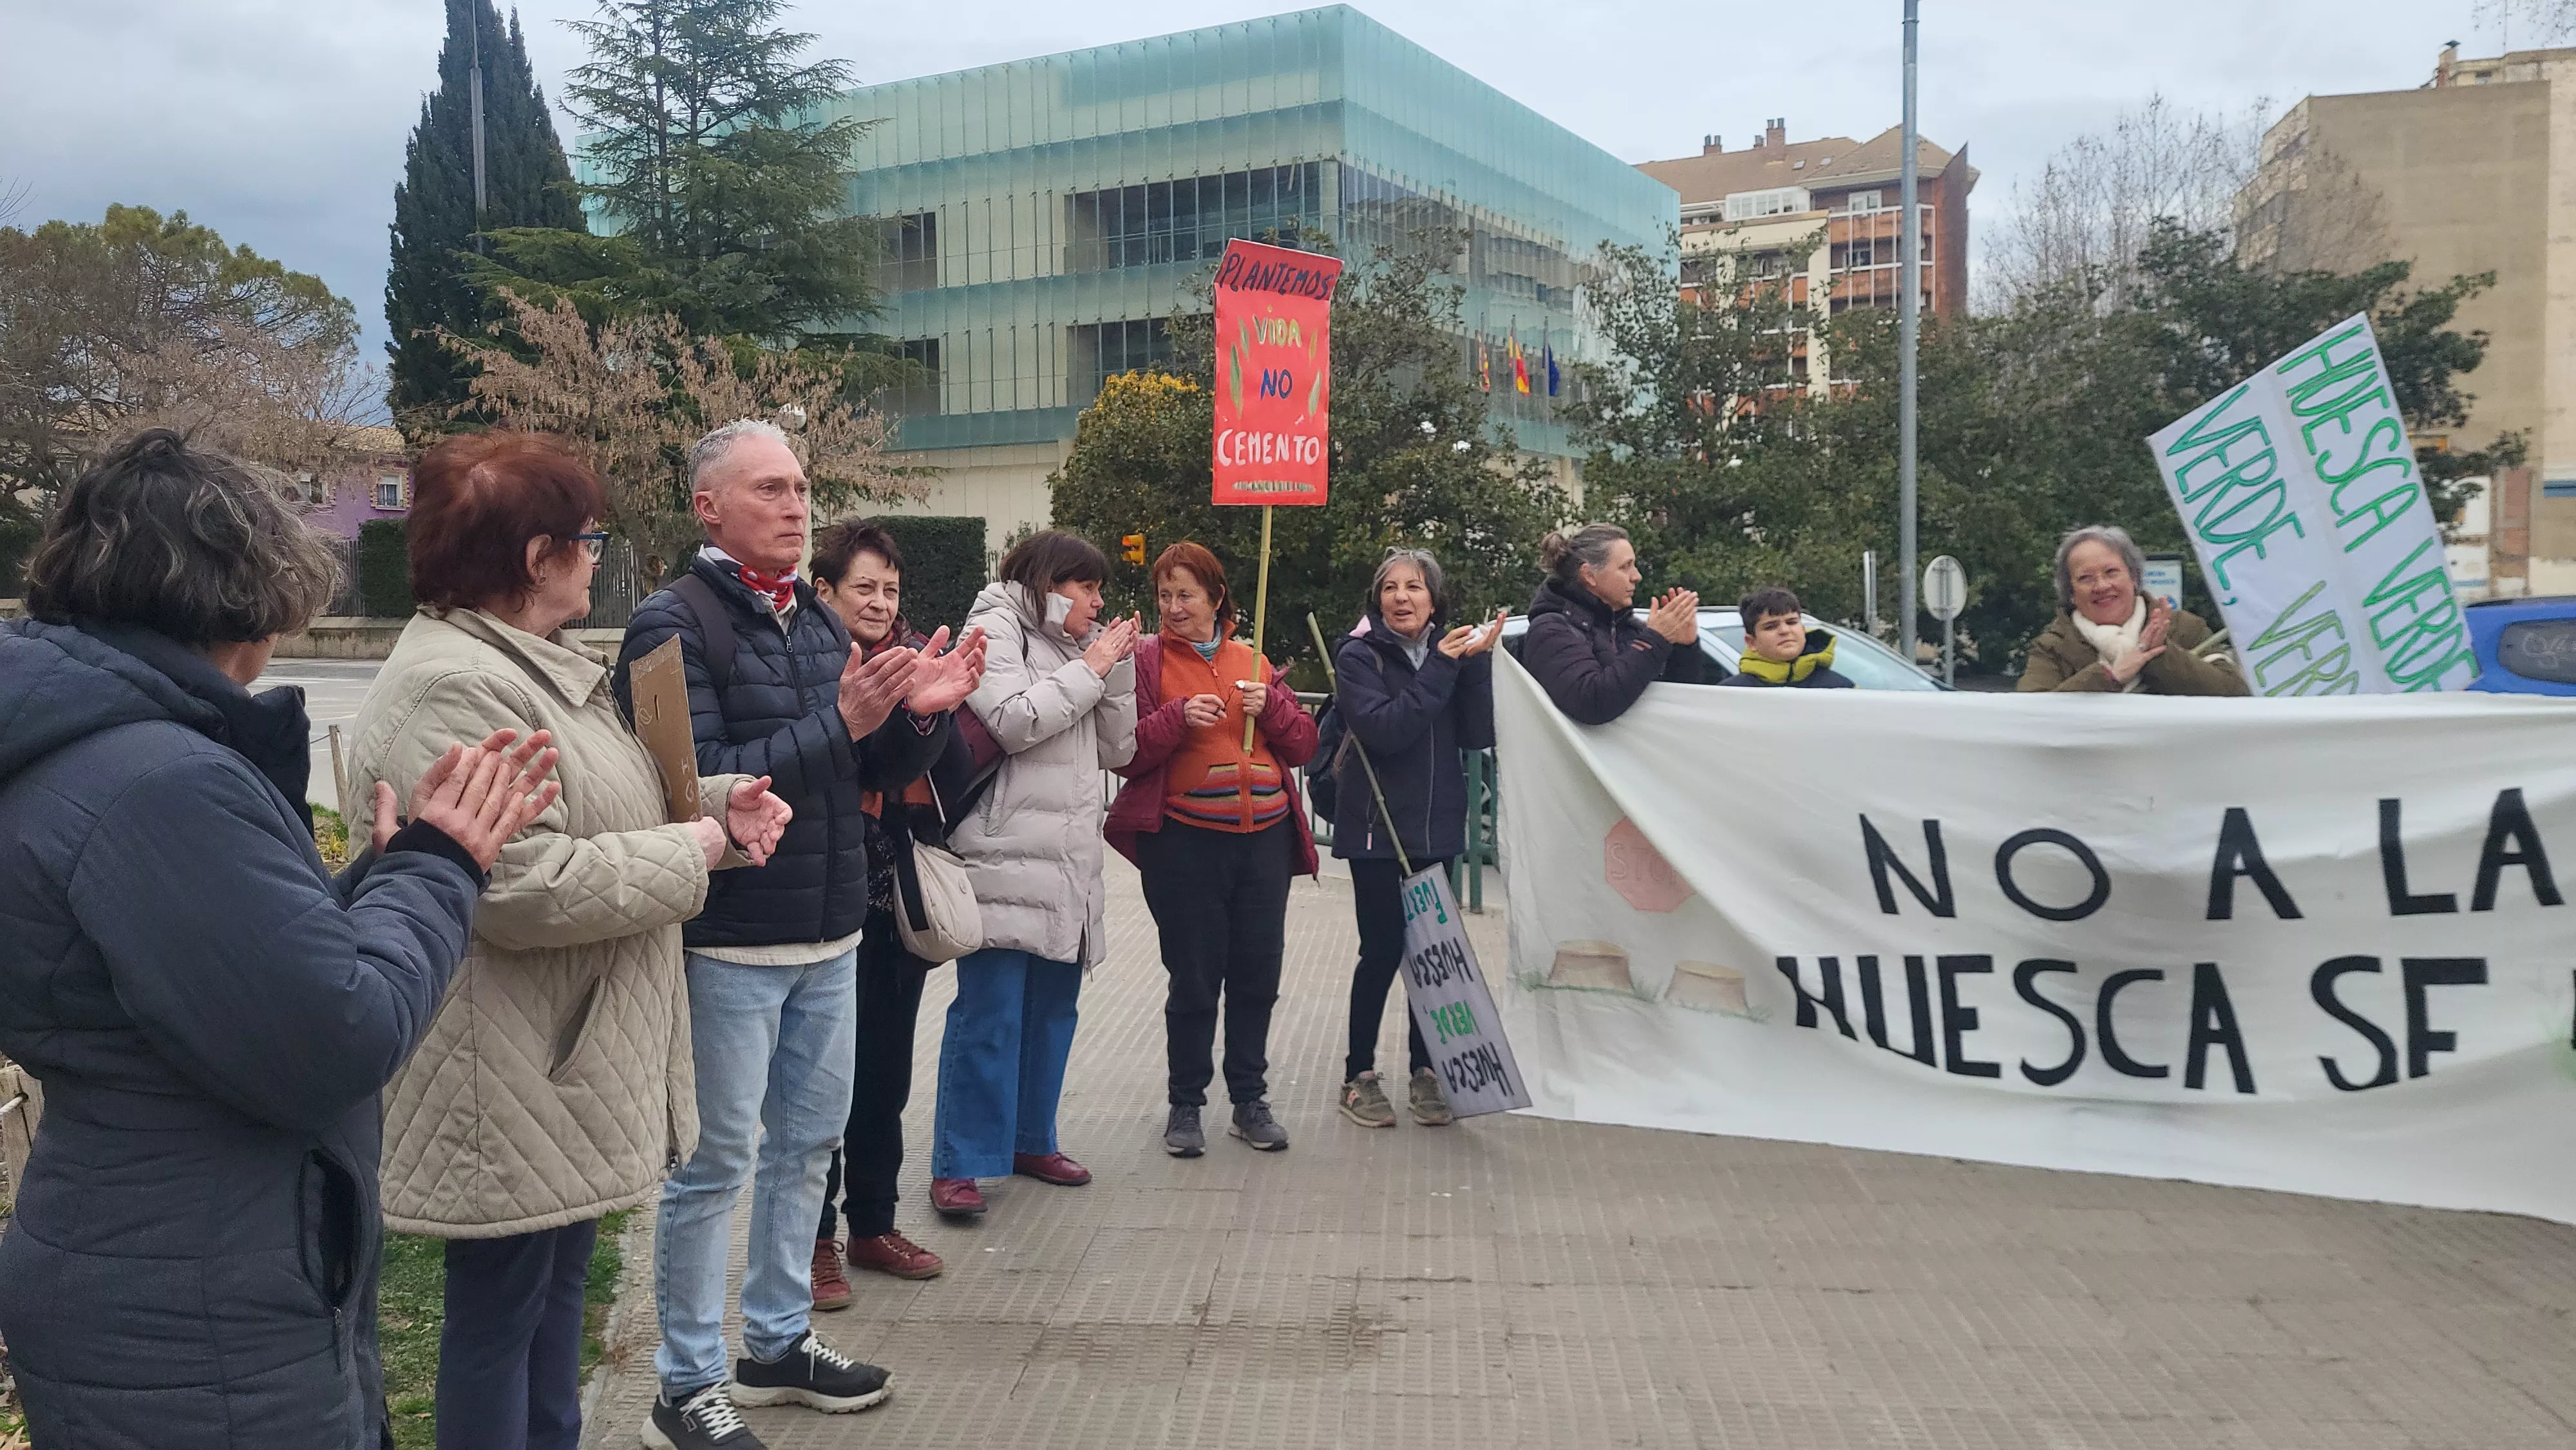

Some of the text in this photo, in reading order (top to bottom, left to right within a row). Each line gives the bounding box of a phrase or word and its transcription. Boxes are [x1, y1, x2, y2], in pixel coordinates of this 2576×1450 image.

[1218, 252, 1334, 301] PLANTEMOS
[1260, 368, 1293, 401] NO
[1217, 428, 1320, 466] CEMENTO
[2277, 323, 2420, 553] HUESCA
[2166, 383, 2306, 606] VERDE,
[1858, 787, 2566, 921] NO A LA
[1409, 936, 1474, 988] HUESCA
[1776, 954, 2258, 1095] HUESCA
[1442, 1041, 1515, 1097] HUESCA
